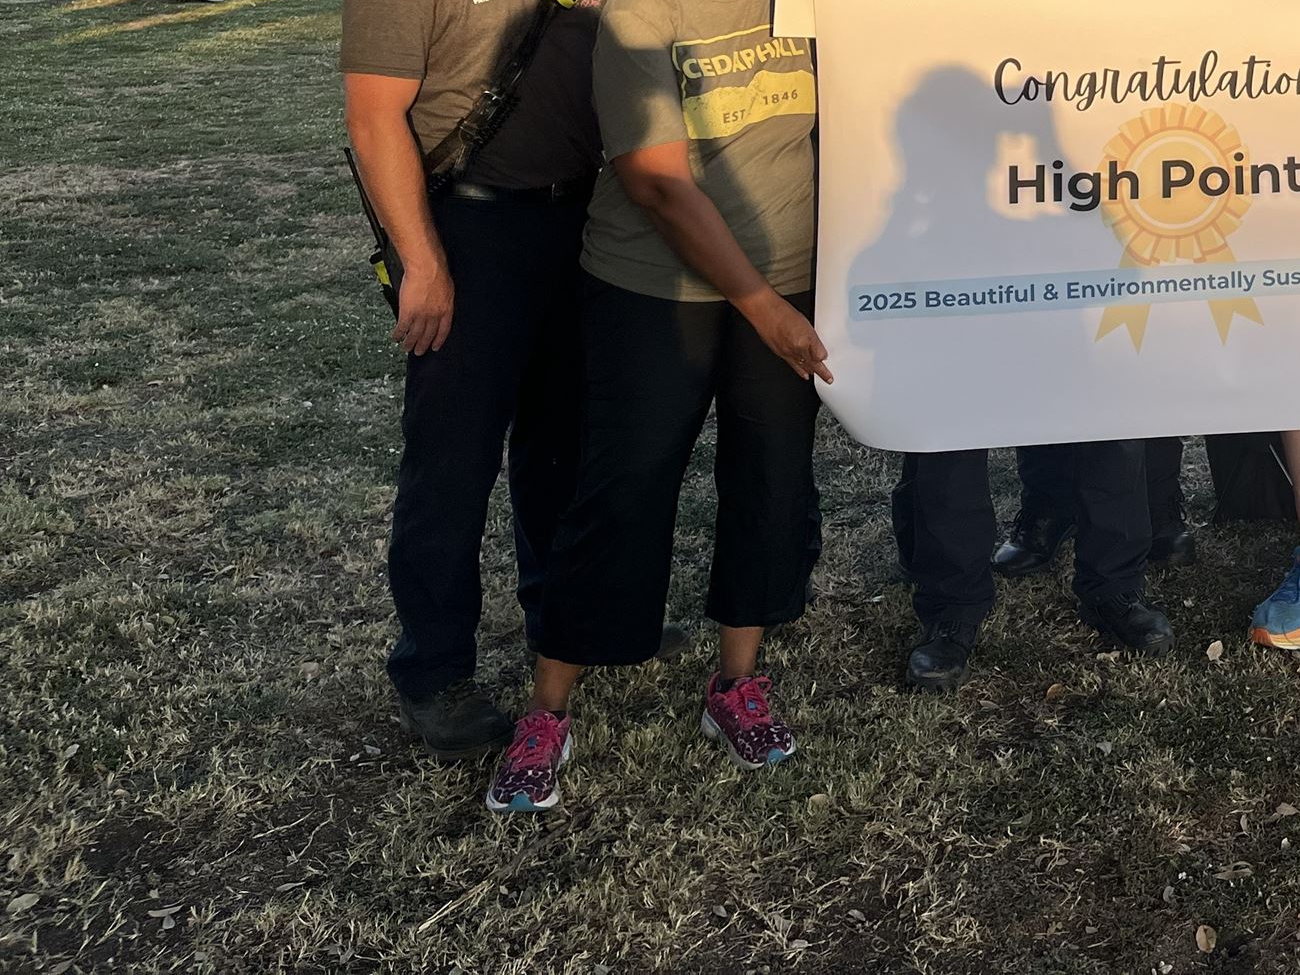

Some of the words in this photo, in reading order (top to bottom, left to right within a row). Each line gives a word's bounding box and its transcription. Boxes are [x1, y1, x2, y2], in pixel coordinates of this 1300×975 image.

[763, 89, 798, 105] 1846
[1008, 158, 1140, 213] High
[857, 291, 917, 312] 2025
[925, 283, 1035, 308] Beautiful
[1043, 283, 1059, 301] &
[1066, 271, 1256, 300] Environmentally
